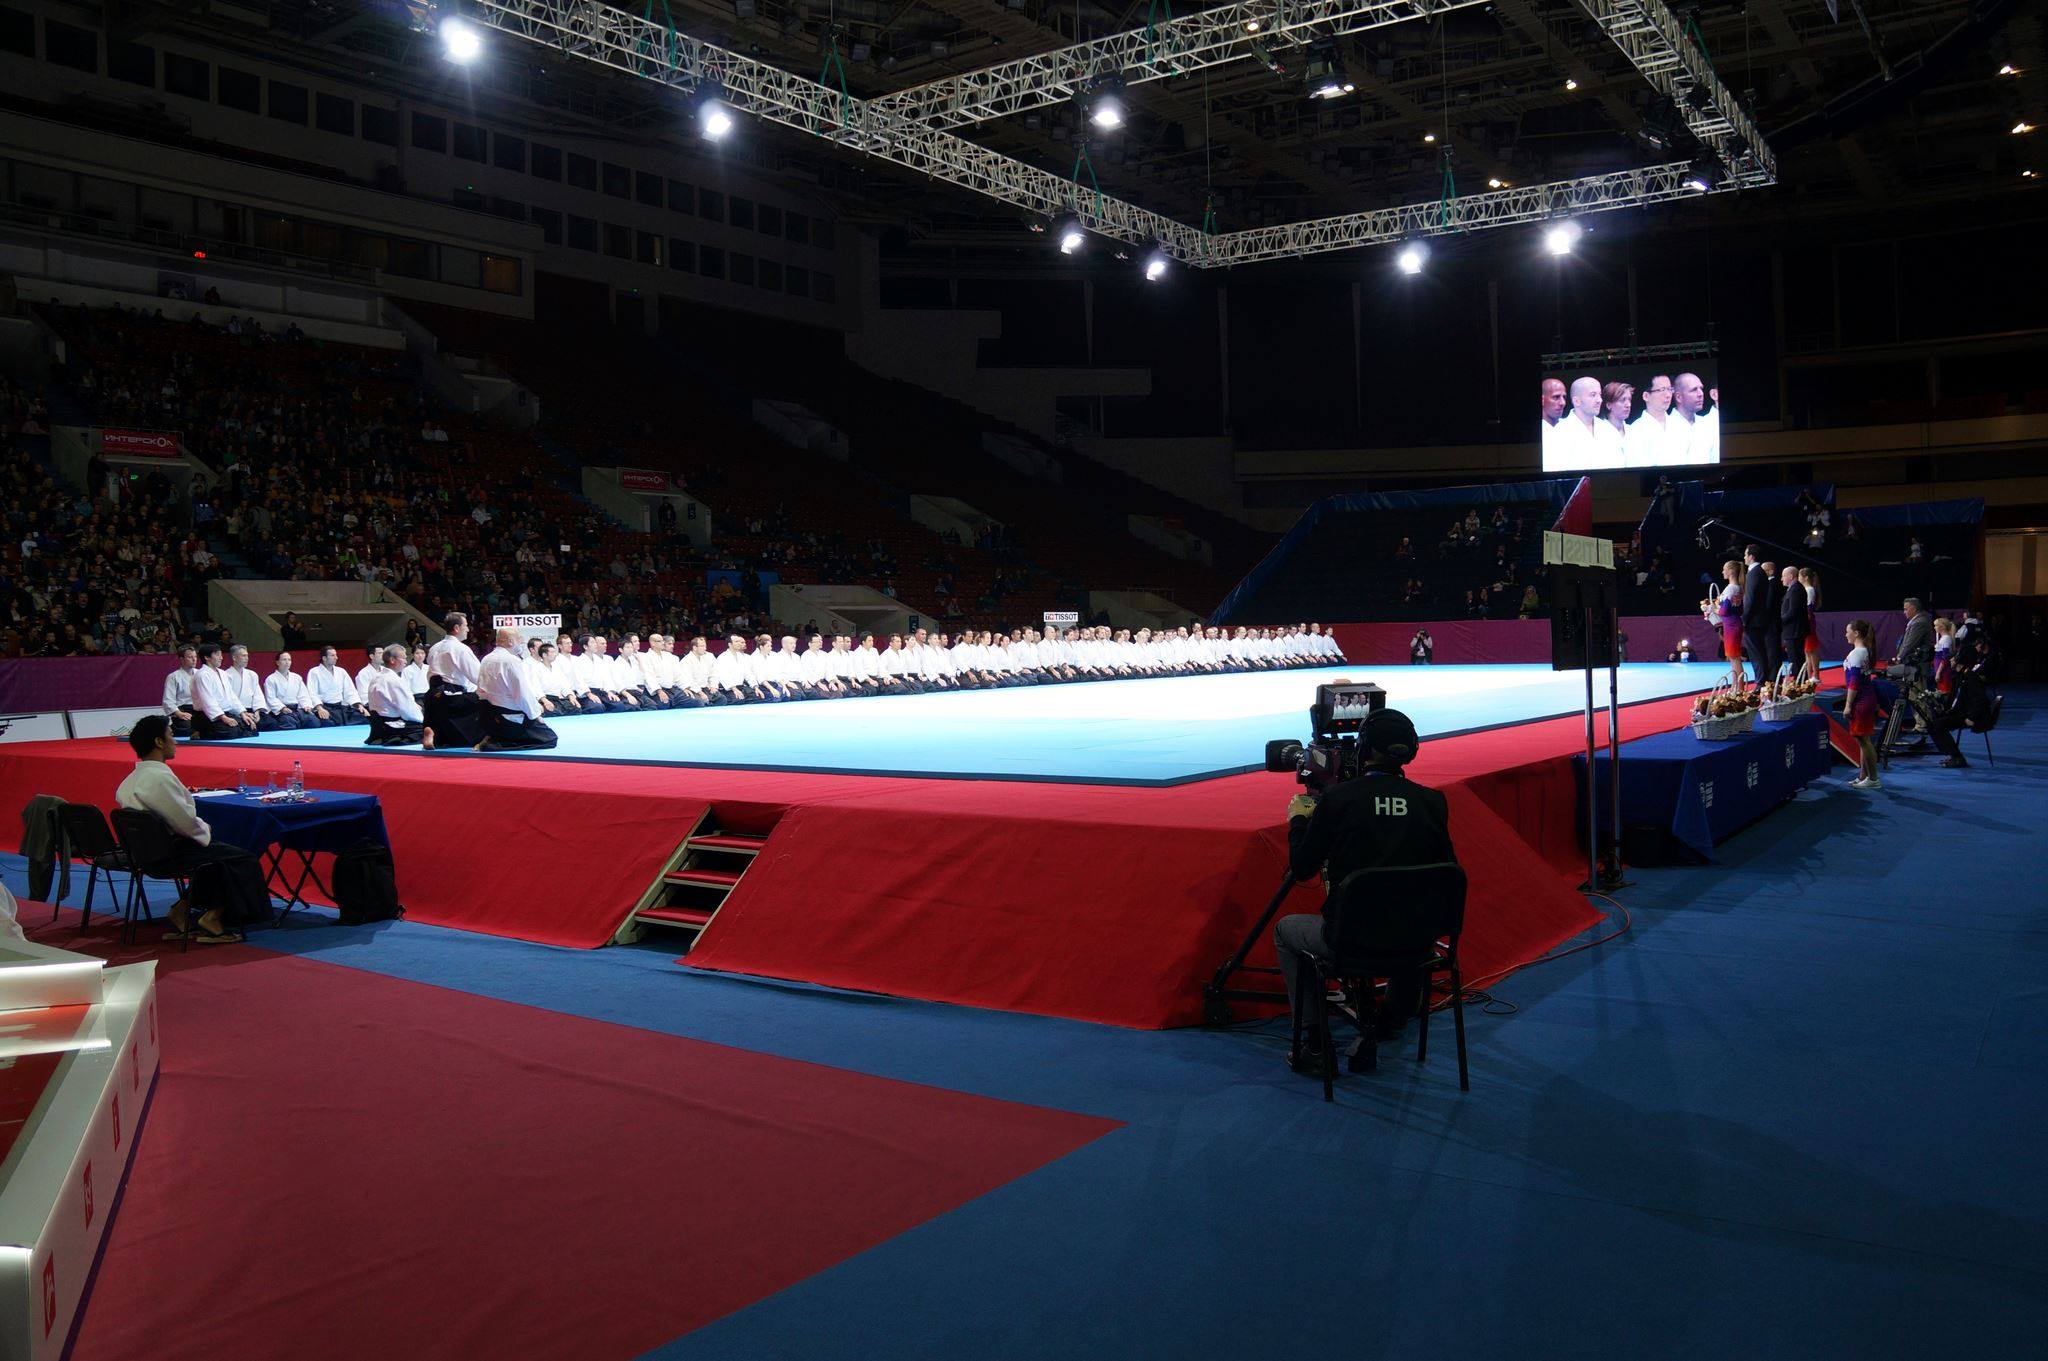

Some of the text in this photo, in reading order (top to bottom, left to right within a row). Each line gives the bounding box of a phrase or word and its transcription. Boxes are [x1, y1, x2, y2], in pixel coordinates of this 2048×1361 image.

[514, 616, 559, 626] TISSOT
[1055, 613, 1078, 621] TISSOT
[1375, 796, 1408, 816] HB
